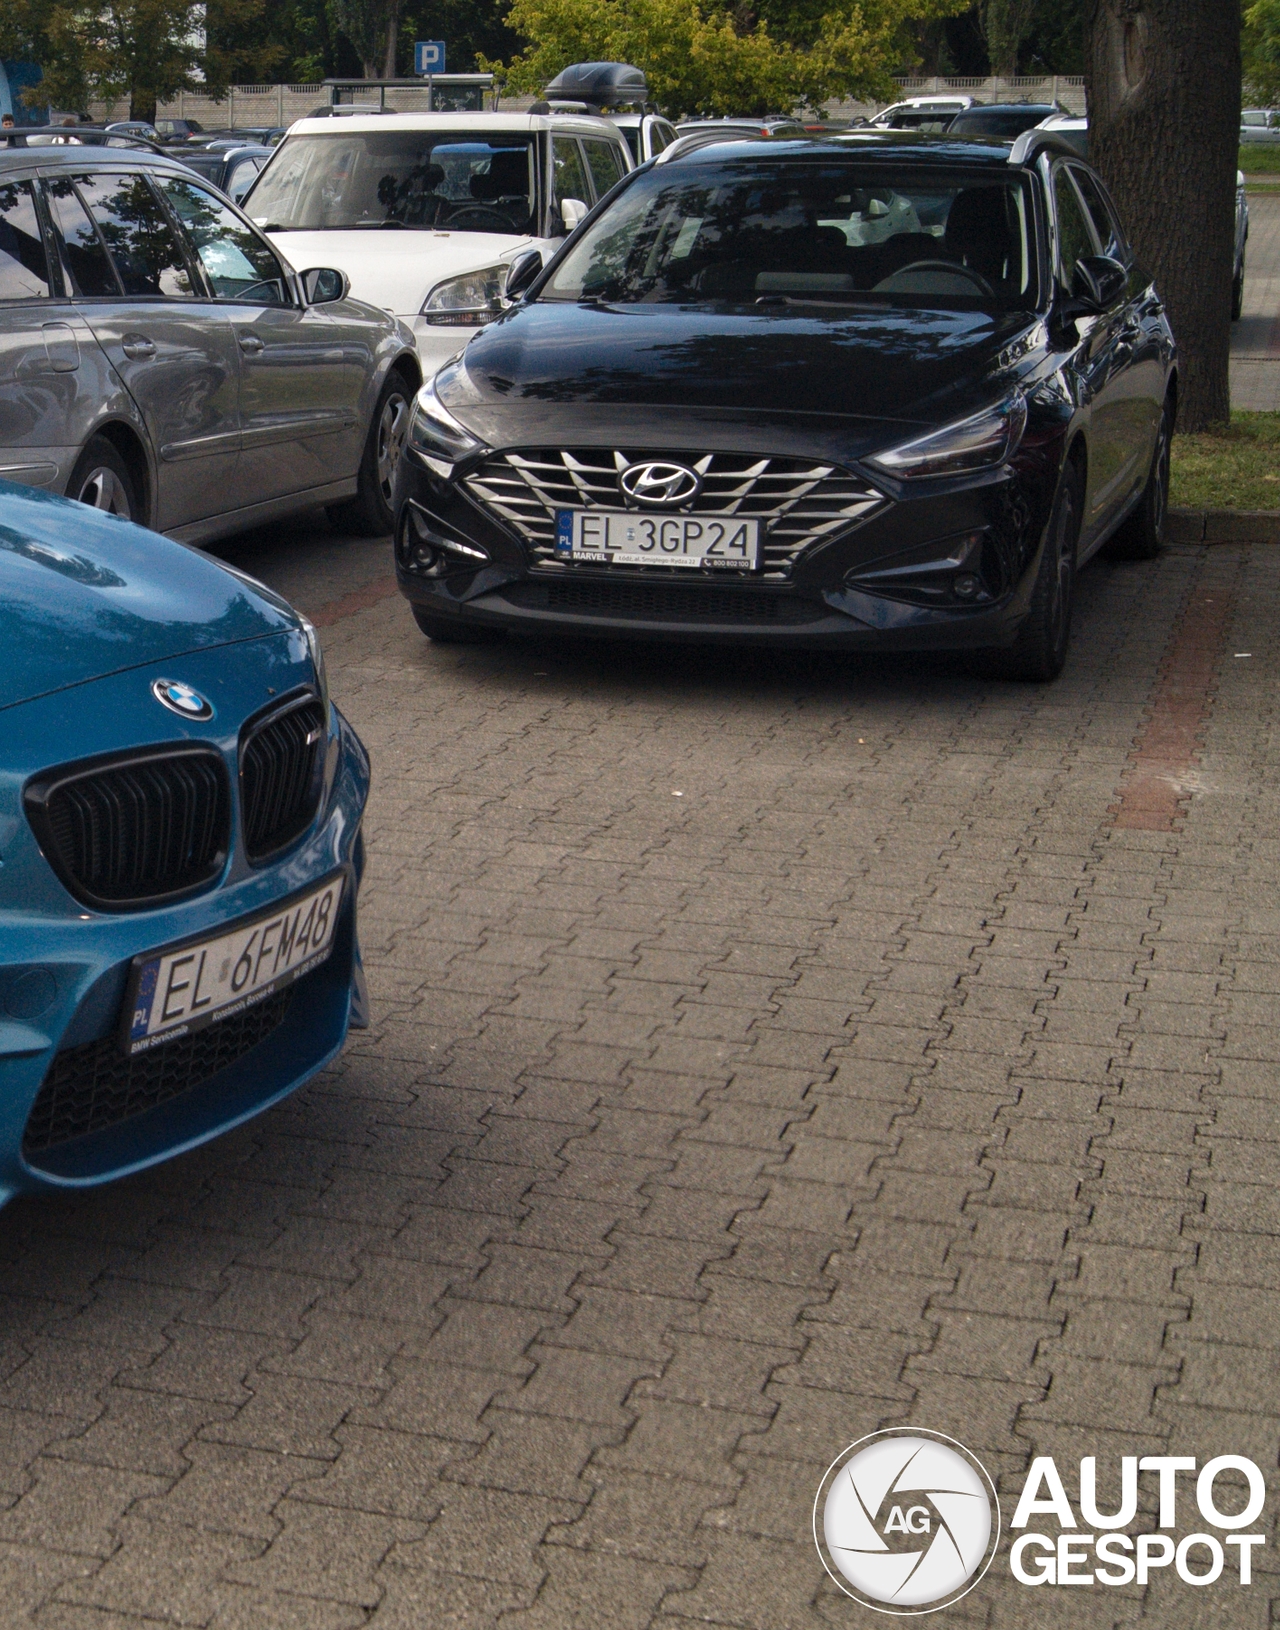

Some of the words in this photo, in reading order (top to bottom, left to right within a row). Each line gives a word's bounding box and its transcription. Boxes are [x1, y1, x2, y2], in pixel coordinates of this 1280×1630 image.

[422, 45, 439, 70] P
[559, 536, 571, 546] PL
[580, 515, 622, 550] EL
[638, 519, 748, 557] 3GP24
[572, 551, 607, 561] MARVEL
[160, 950, 212, 1023] EL
[230, 889, 334, 993] 6FM48
[131, 1010, 148, 1028] PL
